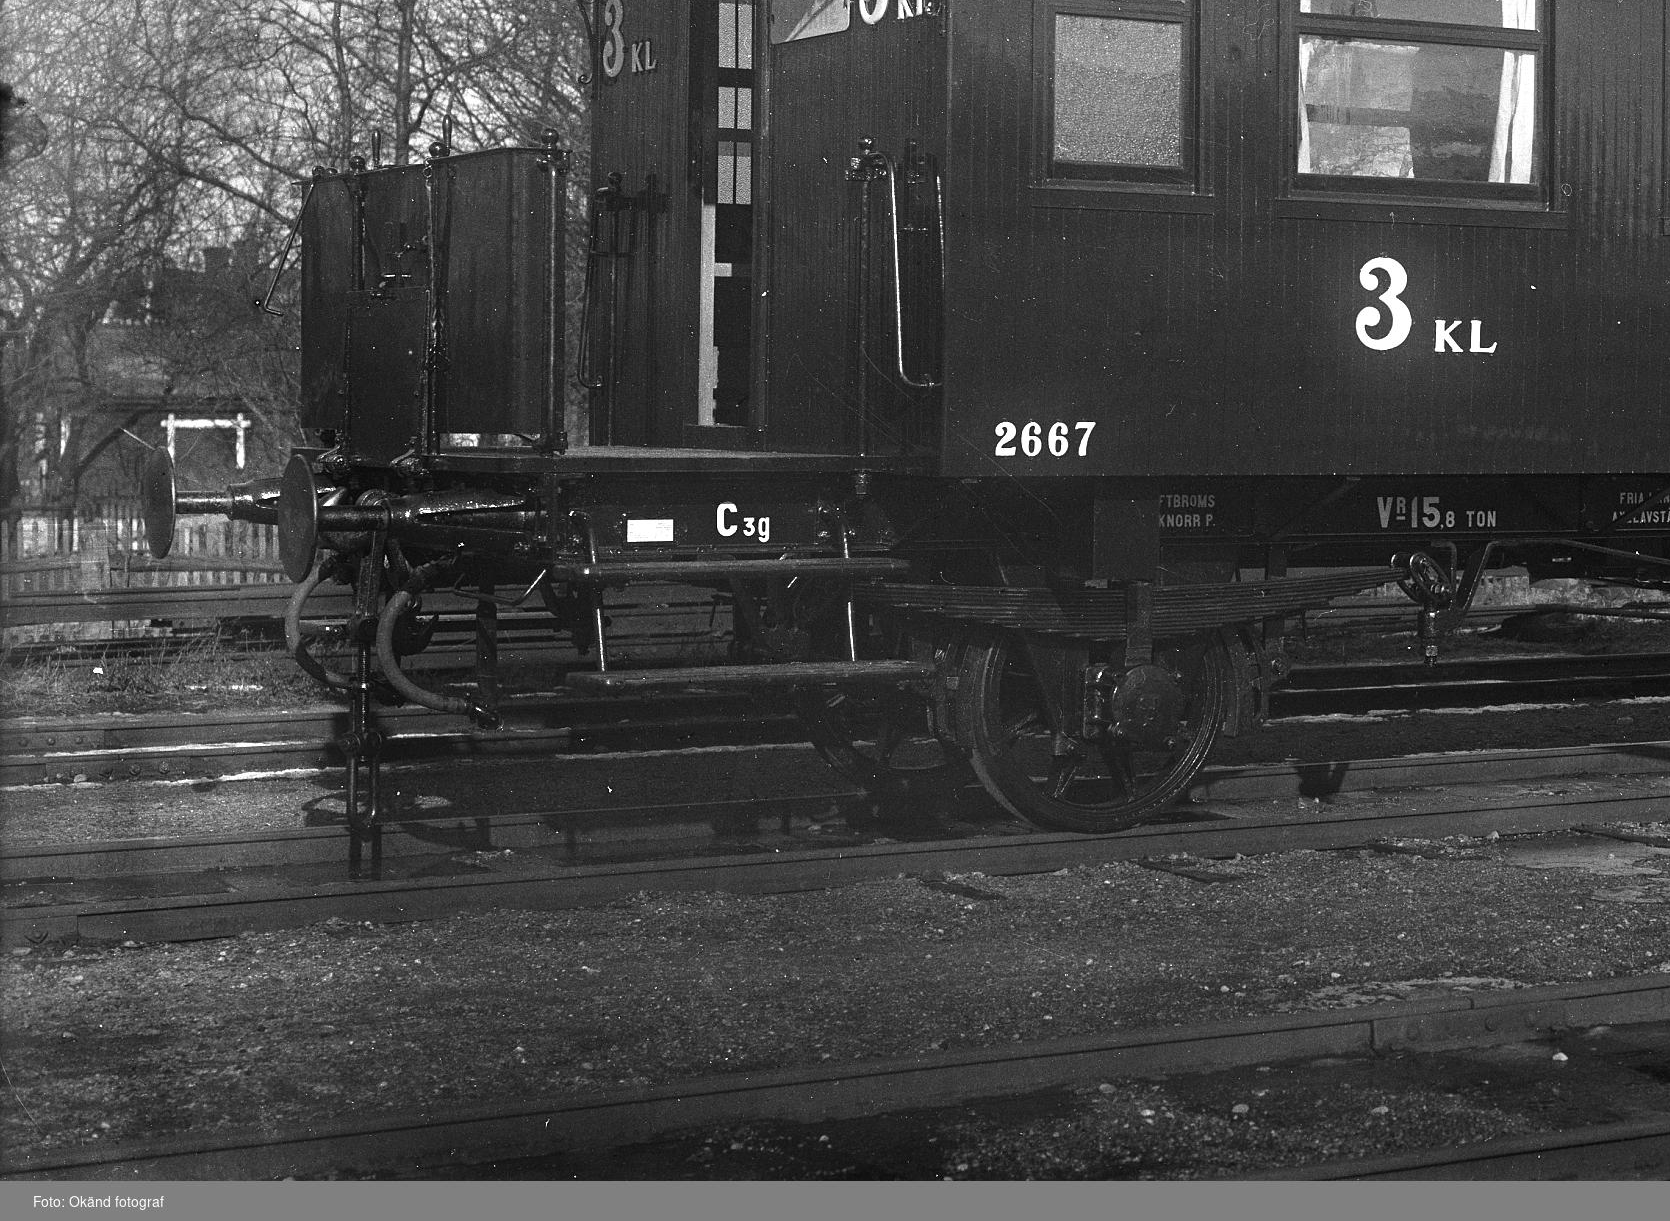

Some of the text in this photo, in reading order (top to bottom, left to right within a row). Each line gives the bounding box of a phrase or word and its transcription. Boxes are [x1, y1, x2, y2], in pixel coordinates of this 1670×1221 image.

[632, 41, 657, 73] KL
[1356, 256, 1498, 354] 3 KL
[994, 421, 1097, 457] 2667
[1619, 492, 1645, 505] FRIA
[1158, 513, 1201, 527] KNORR
[1466, 510, 1497, 528] TON
